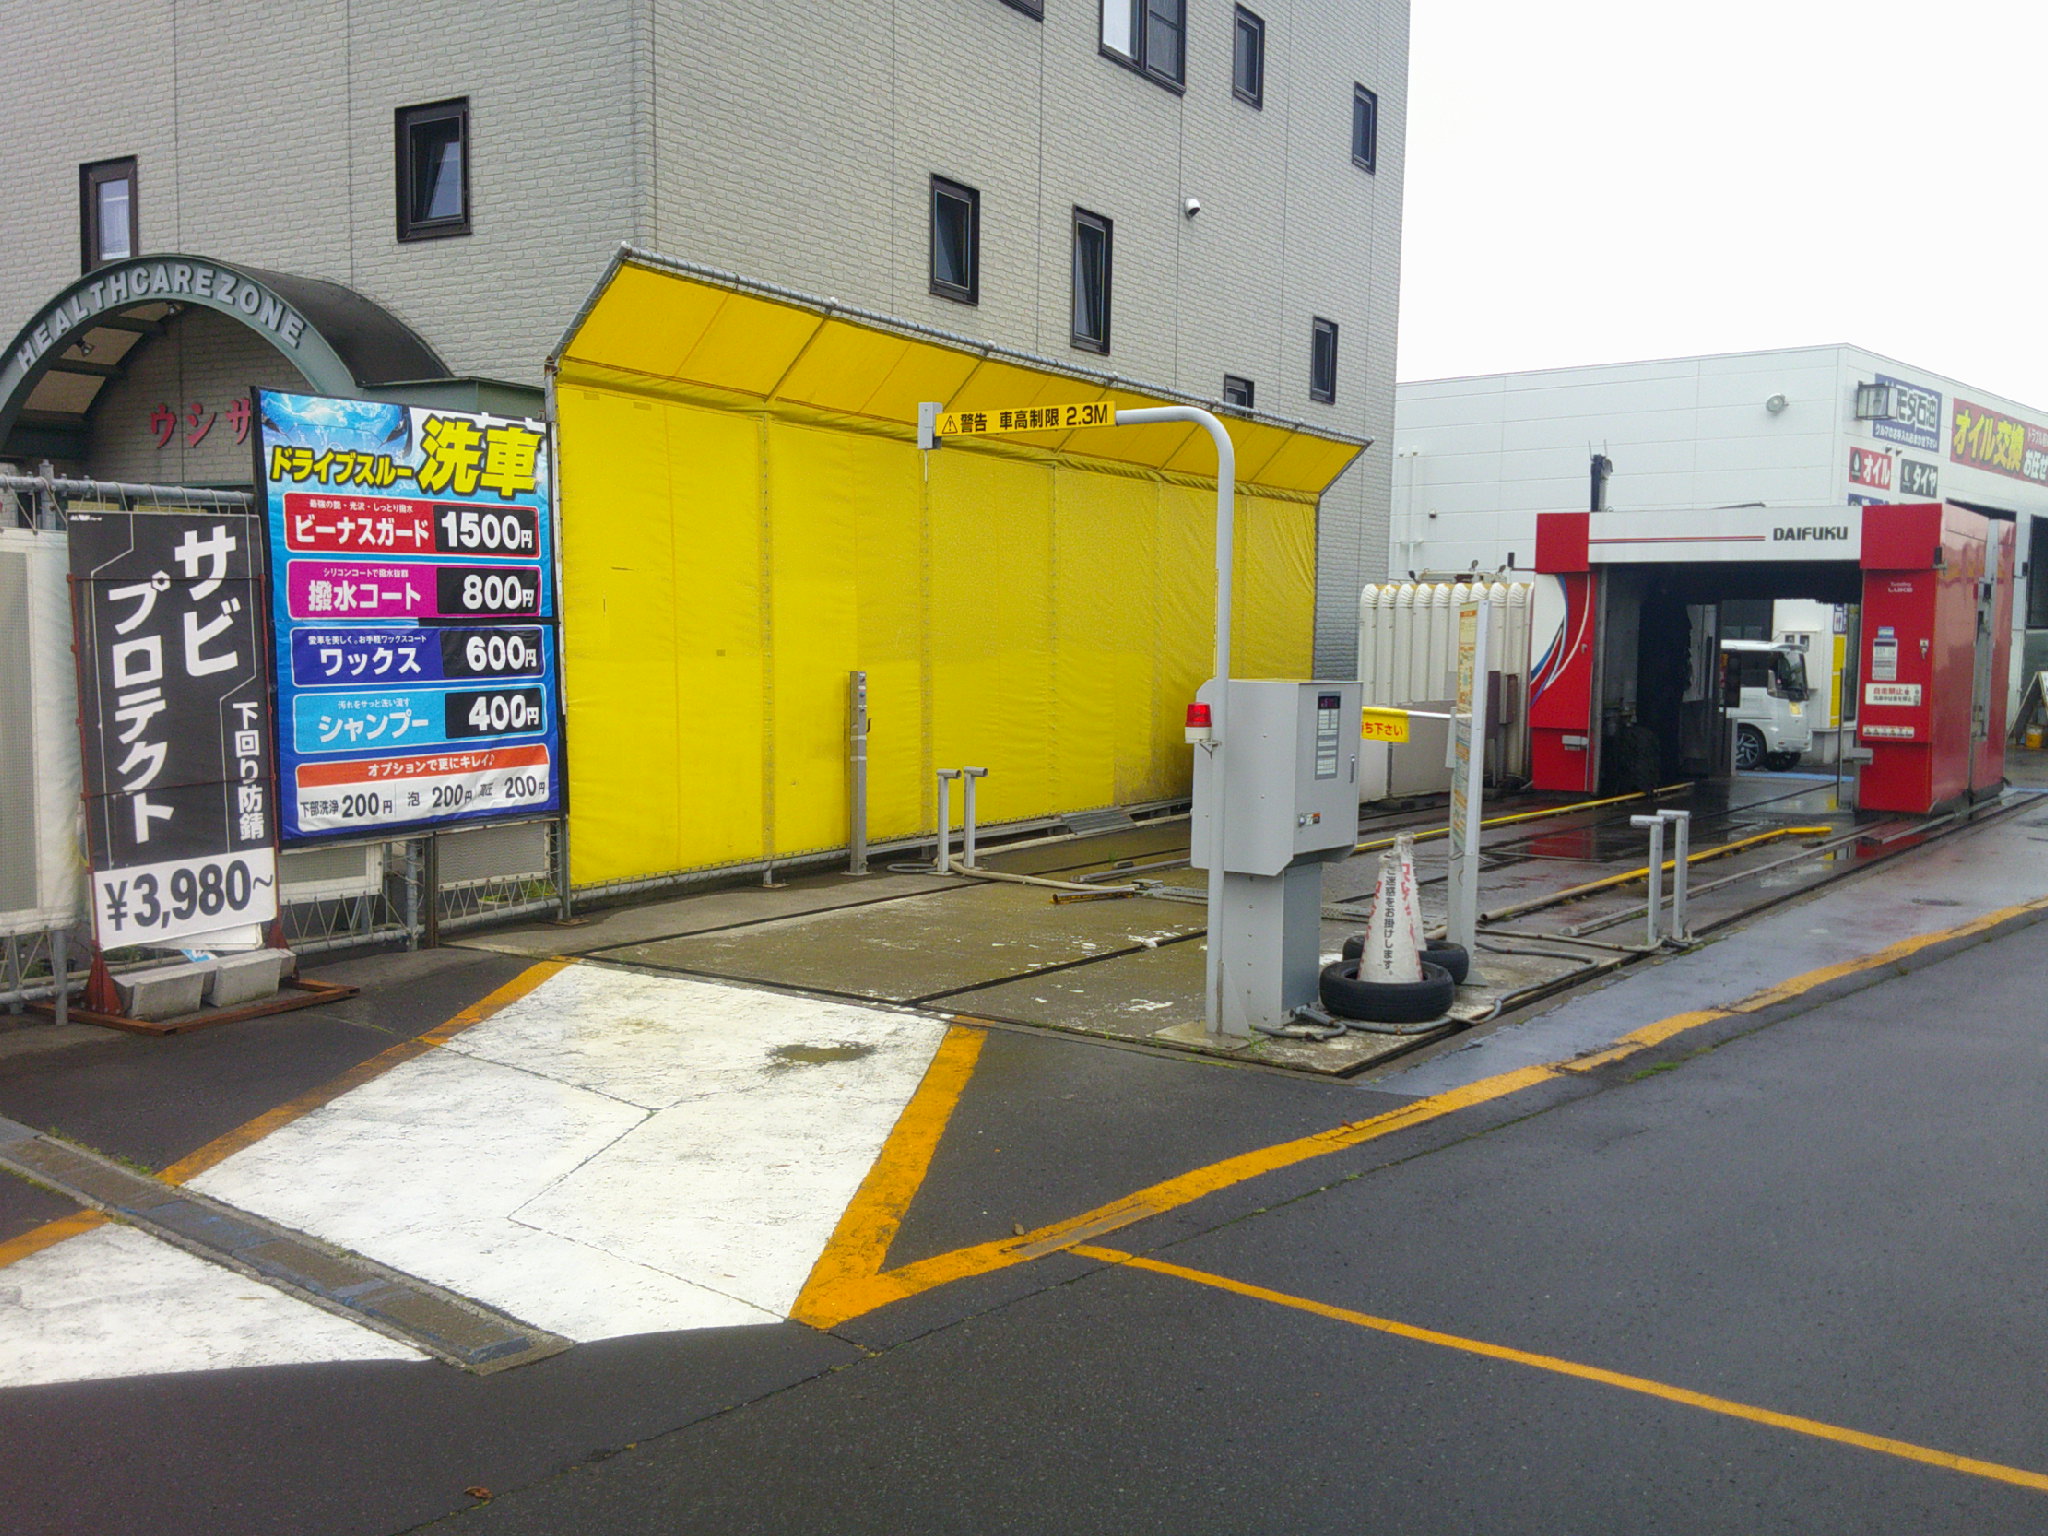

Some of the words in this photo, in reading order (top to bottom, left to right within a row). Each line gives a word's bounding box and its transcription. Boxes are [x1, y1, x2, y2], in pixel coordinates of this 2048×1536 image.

[960, 413, 987, 433] 警告
[999, 408, 1060, 430] 車高制限
[1066, 404, 1108, 426] 2.3M
[272, 446, 414, 486] ドライブスルー
[418, 416, 546, 497] 洗車
[1953, 409, 2026, 472] オイル交換
[1863, 454, 1891, 486] オイル
[1912, 464, 1938, 495] タイヤ
[295, 514, 429, 547] ビーナスガード
[441, 511, 533, 550] 1500円
[1773, 526, 1848, 542] DAIFUKU
[175, 525, 241, 677] サビ
[308, 579, 422, 612] 撥水コート
[462, 575, 535, 610] 800円
[320, 647, 421, 676] ワックス
[466, 635, 537, 671] 600円
[108, 570, 174, 844] プロテクト
[468, 694, 540, 731] 400円
[318, 709, 429, 742] シャンプー
[1362, 721, 1403, 736] ち下さい
[232, 702, 265, 842] 下回り防錆
[301, 801, 339, 818] 下部洗浄
[408, 791, 420, 806] 泡
